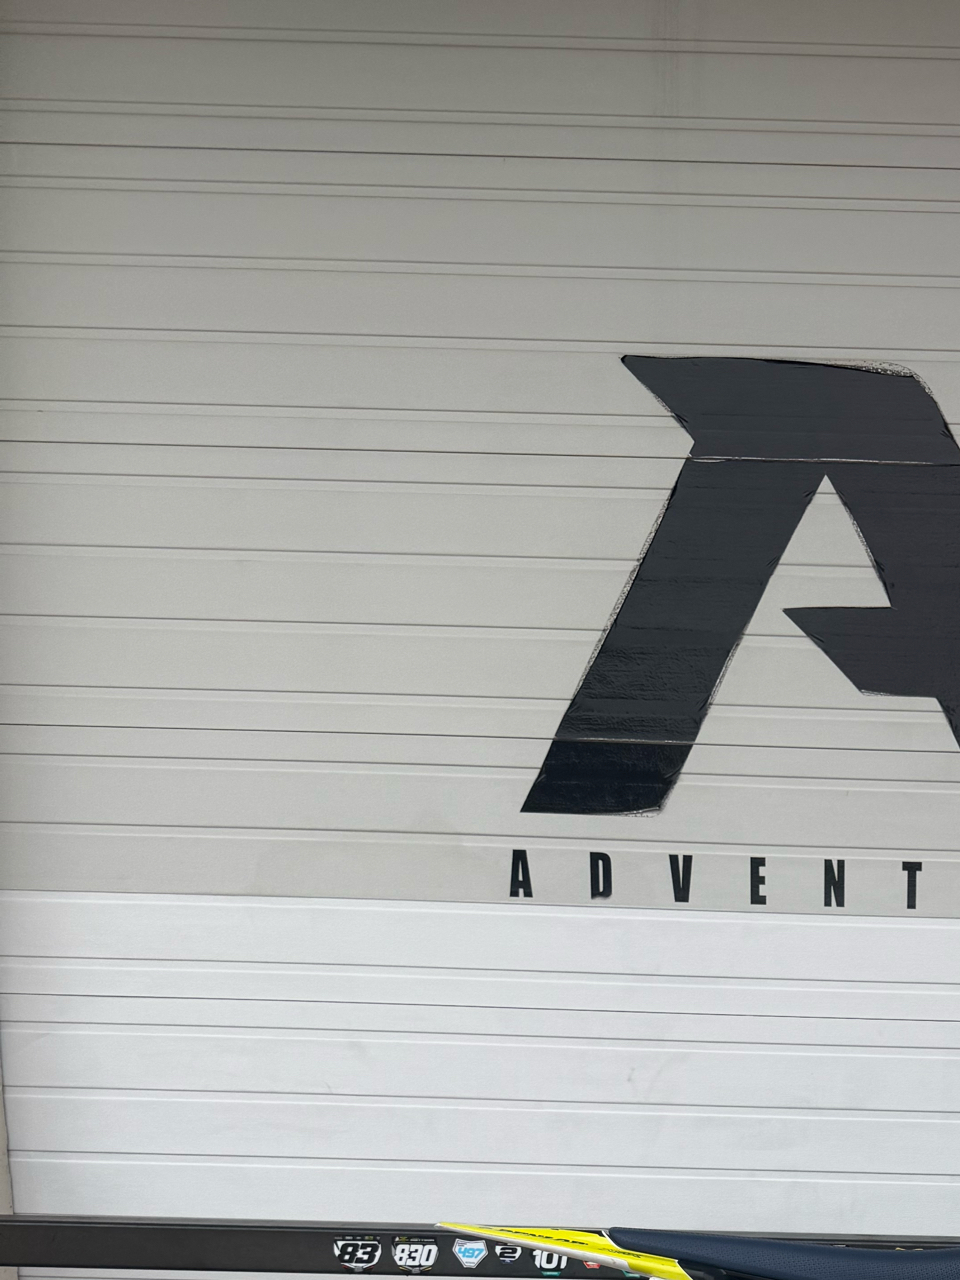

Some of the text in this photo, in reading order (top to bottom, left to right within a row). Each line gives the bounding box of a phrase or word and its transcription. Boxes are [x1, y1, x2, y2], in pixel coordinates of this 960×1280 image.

[340, 1242, 377, 1263] 83
[394, 1244, 438, 1266] 830
[457, 1247, 484, 1259] 497
